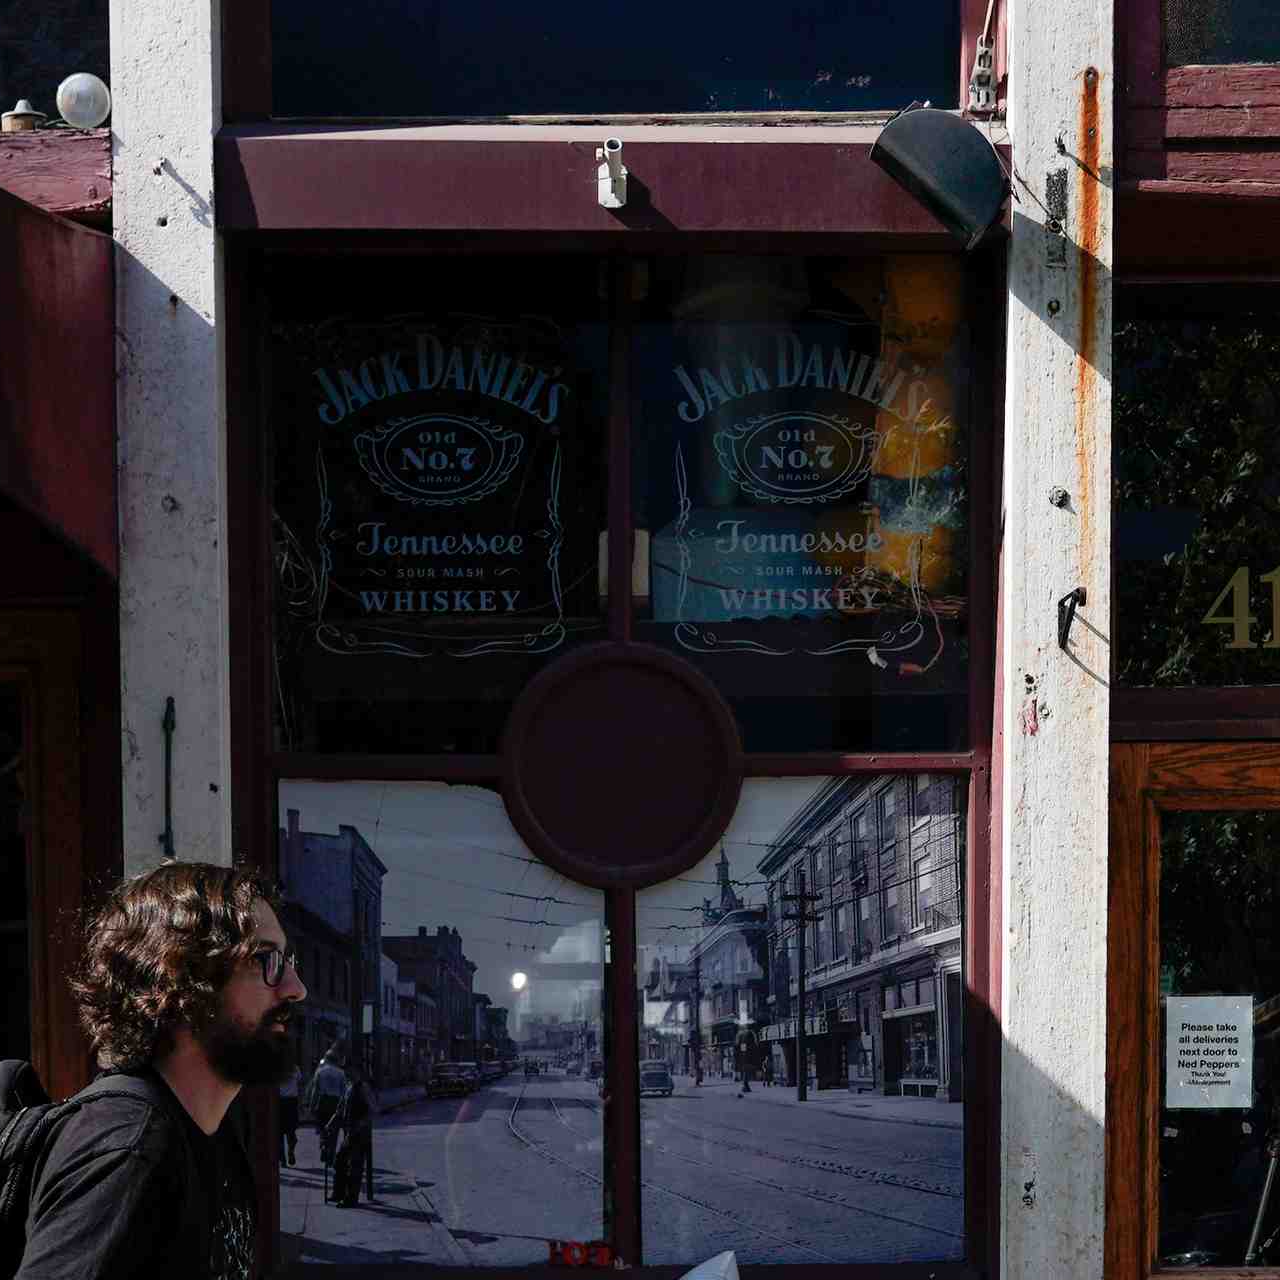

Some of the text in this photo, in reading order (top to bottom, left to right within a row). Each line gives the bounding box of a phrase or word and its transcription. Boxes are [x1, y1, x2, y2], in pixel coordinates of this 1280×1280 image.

[312, 352, 412, 425] JACK
[673, 352, 772, 423] JACK
[355, 522, 523, 556] Tennessee
[715, 520, 882, 554] Tennessee
[802, 566, 843, 576] MASH
[360, 590, 521, 612] WHISKEY
[720, 588, 880, 610] WHISKEY
[1181, 1023, 1237, 1032] Please take
[1178, 1035, 1239, 1044] all deliveries
[1179, 1048, 1238, 1056] next door to
[1178, 1060, 1240, 1070] Ned Peppers
